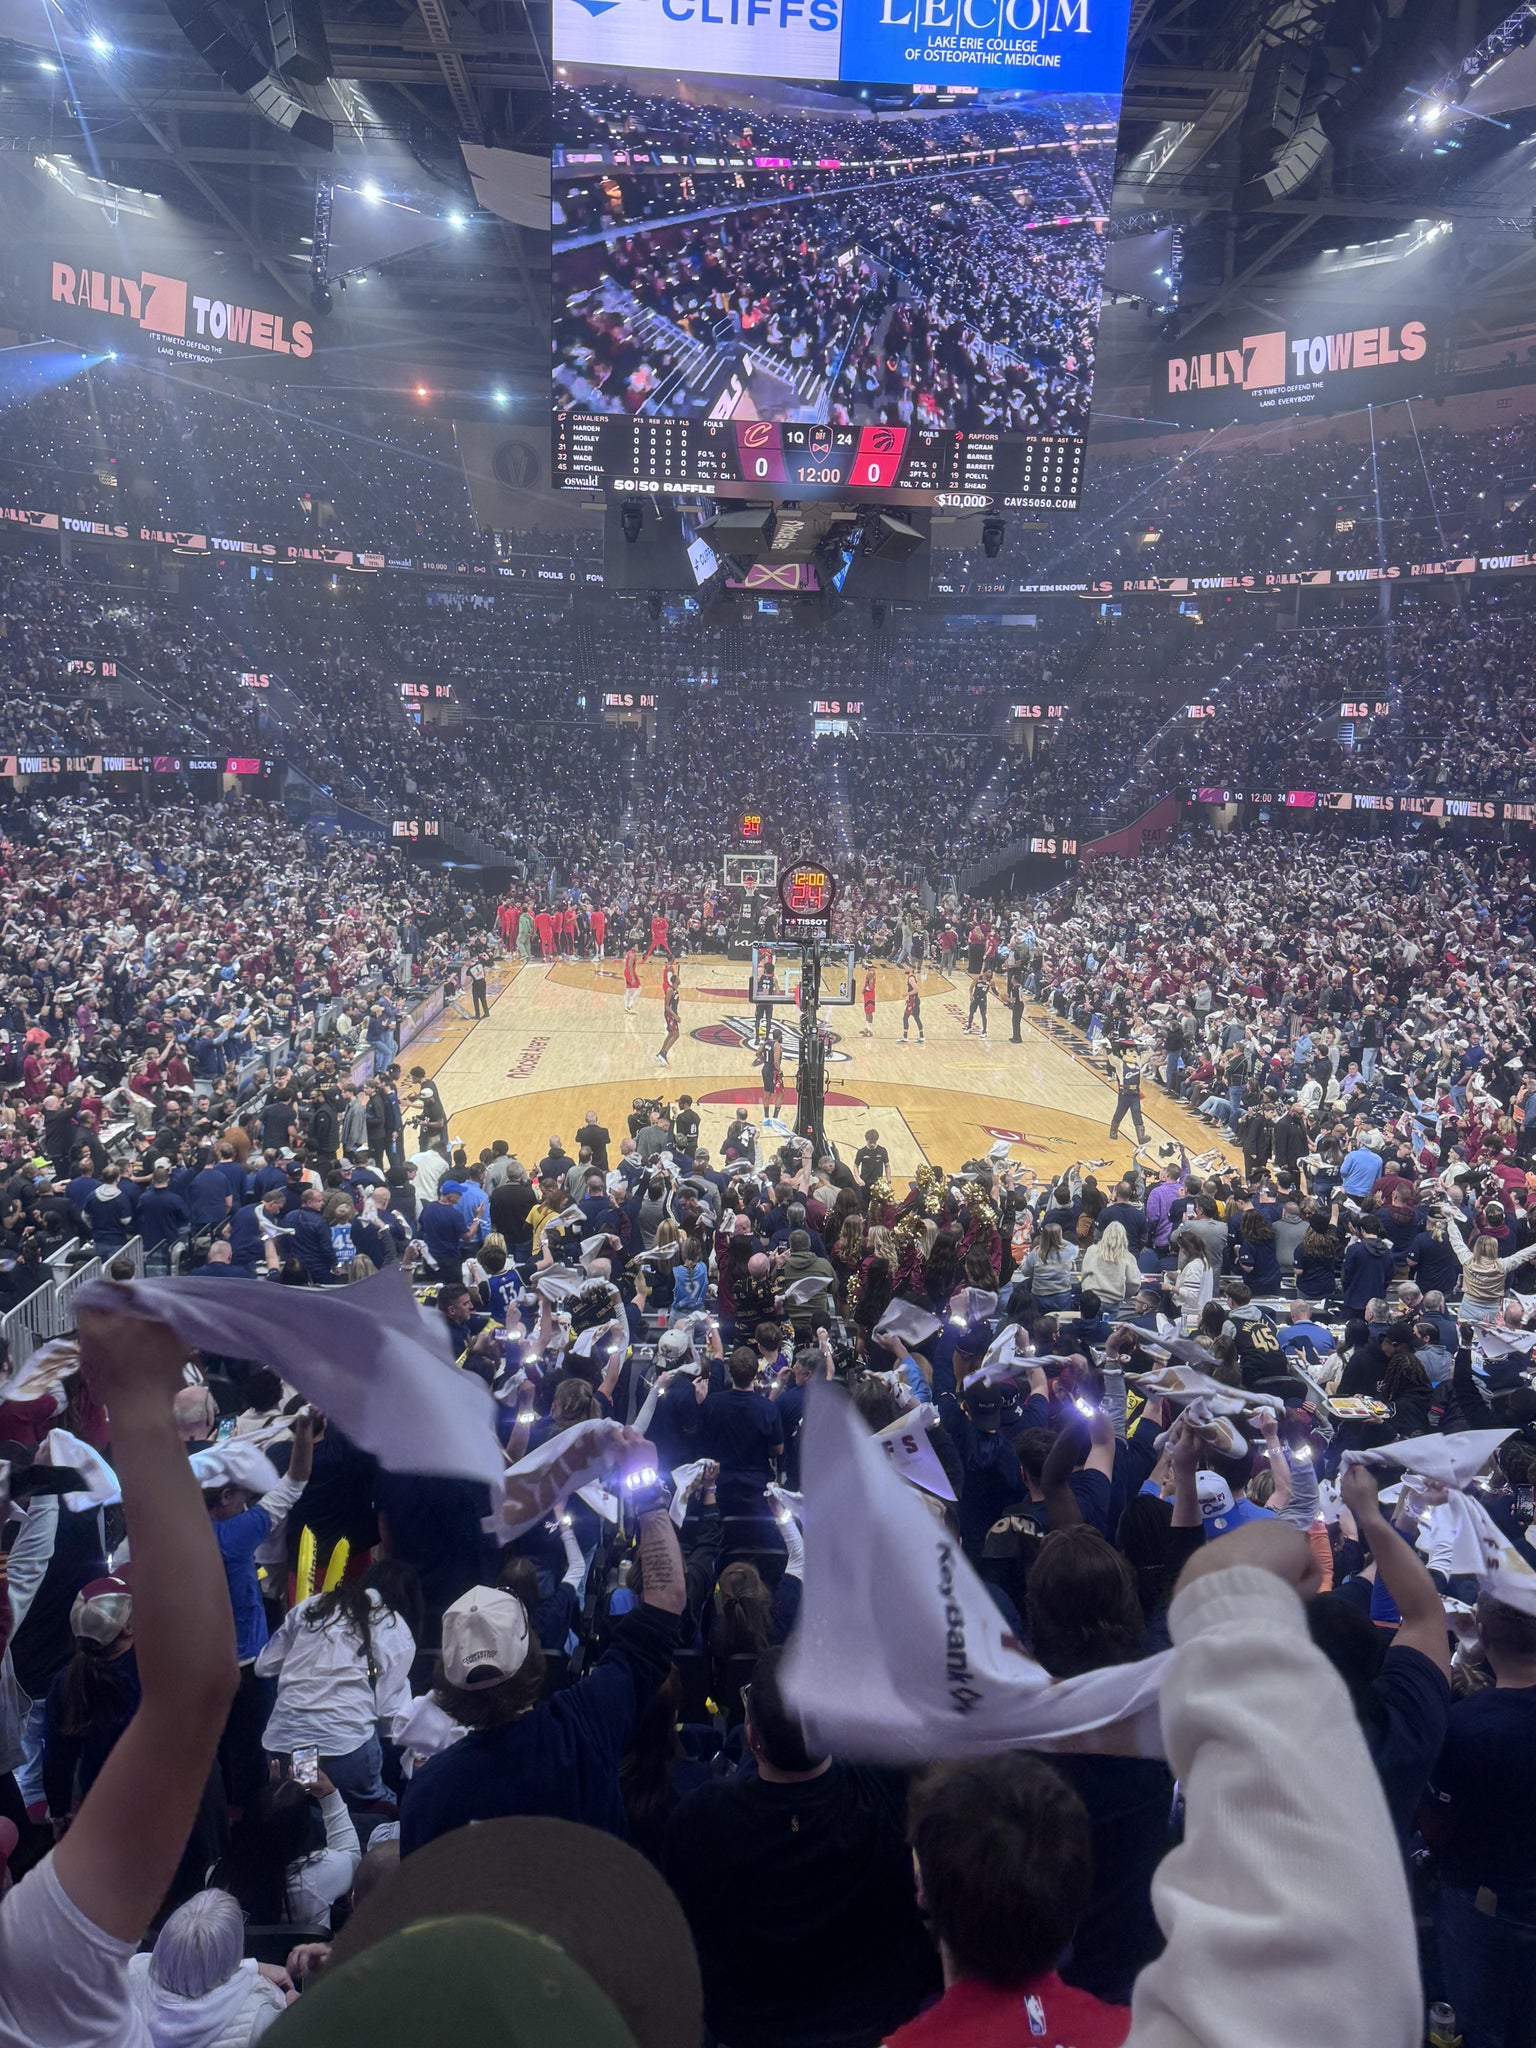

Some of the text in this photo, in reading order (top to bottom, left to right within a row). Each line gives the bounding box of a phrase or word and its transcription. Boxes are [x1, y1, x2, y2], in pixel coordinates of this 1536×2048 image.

[662, 0, 839, 32] CLIFFS
[927, 35, 1038, 53] LAKE ERIE COLLEGE
[905, 48, 1061, 67] OF OSTEOPATHIC MEDICINE
[192, 295, 314, 358] TOWELS
[150, 332, 223, 354] IT'S DEFEND THE
[1291, 321, 1427, 376] TOWELS
[176, 350, 214, 364] EVERYBODY
[1286, 384, 1311, 392] DEFEND
[1278, 394, 1316, 405] EVERYBODY
[572, 414, 609, 422] CAVALIERS
[787, 432, 804, 444] 1Q
[837, 434, 852, 445] 24
[926, 437, 931, 445] 0
[755, 458, 768, 477] 0
[798, 467, 840, 483] 12:00
[868, 464, 880, 482] 0
[564, 475, 599, 486] oswald
[664, 482, 715, 494] RAFFLE
[939, 494, 986, 508] $10,000
[1004, 497, 1076, 508] CAVS5050.COM
[62, 517, 129, 538] TOWELS
[140, 528, 193, 546] RALLY
[211, 538, 277, 556] TOWELS
[288, 546, 340, 562] RALLY
[498, 568, 514, 576] TOL
[521, 569, 526, 577] 7
[538, 571, 563, 579] FOULS
[1124, 578, 1176, 591] RALLY
[1192, 574, 1255, 590] TOWELS
[1265, 572, 1320, 586] RALLY
[1336, 566, 1400, 581] TOWELS
[1410, 561, 1463, 576] RALLY
[19, 757, 60, 773] TOWELS
[175, 760, 237, 770] 0 BLOCKS 0
[1223, 791, 1229, 801] 0
[1250, 793, 1272, 803] 12:00
[1278, 794, 1286, 802] 24
[1290, 794, 1295, 804] 0
[1354, 795, 1394, 810] TOWELS
[1446, 800, 1496, 819] TOWELS
[743, 823, 759, 836] 24
[795, 873, 824, 886] 12:00
[792, 884, 821, 908] 24
[1251, 1328, 1280, 1352] 45
[936, 1542, 974, 1684] KeyBank
